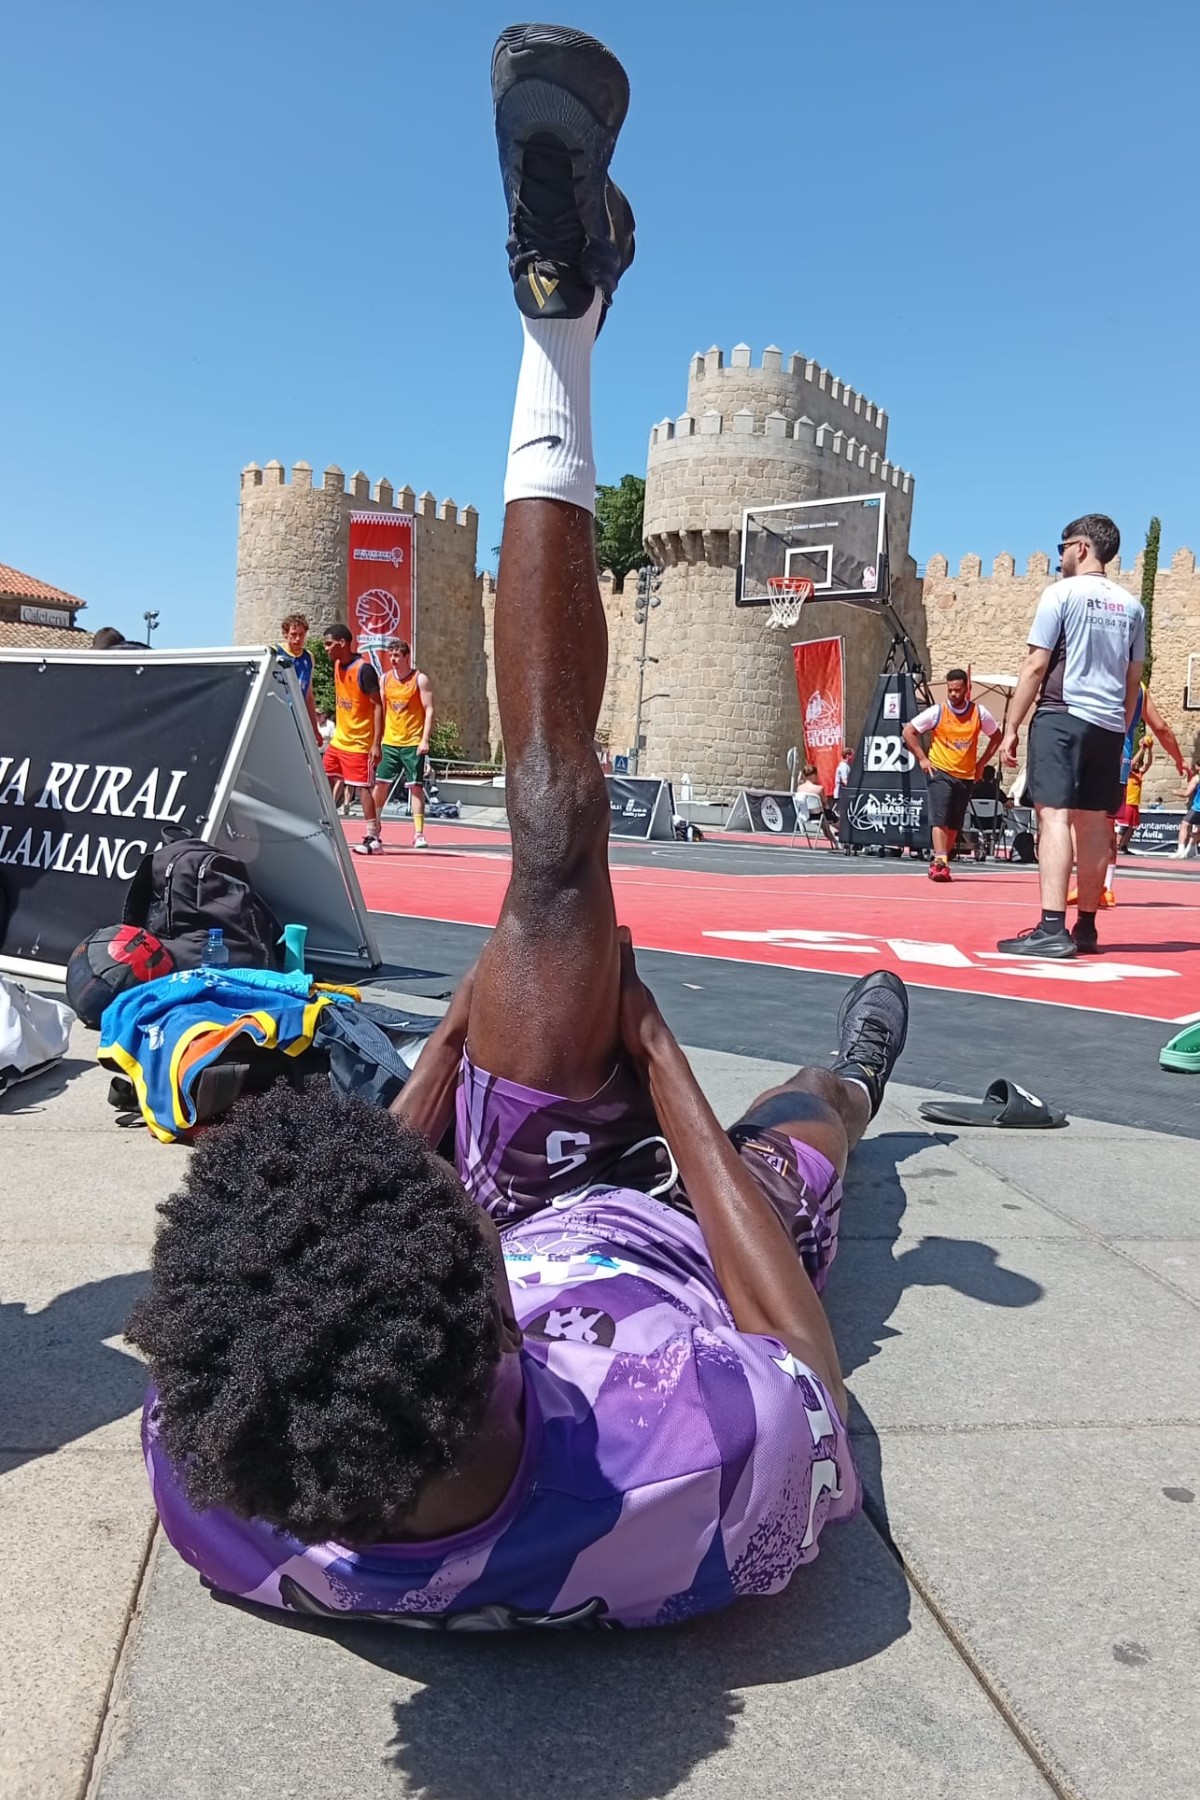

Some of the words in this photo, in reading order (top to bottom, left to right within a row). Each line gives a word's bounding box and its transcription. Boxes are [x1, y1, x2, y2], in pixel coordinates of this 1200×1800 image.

[889, 703, 896, 713] 2
[34, 761, 188, 823] RURAL
[881, 805, 923, 815] BASKET
[880, 814, 921, 827] TOUR
[1142, 828, 1163, 839] Ávila
